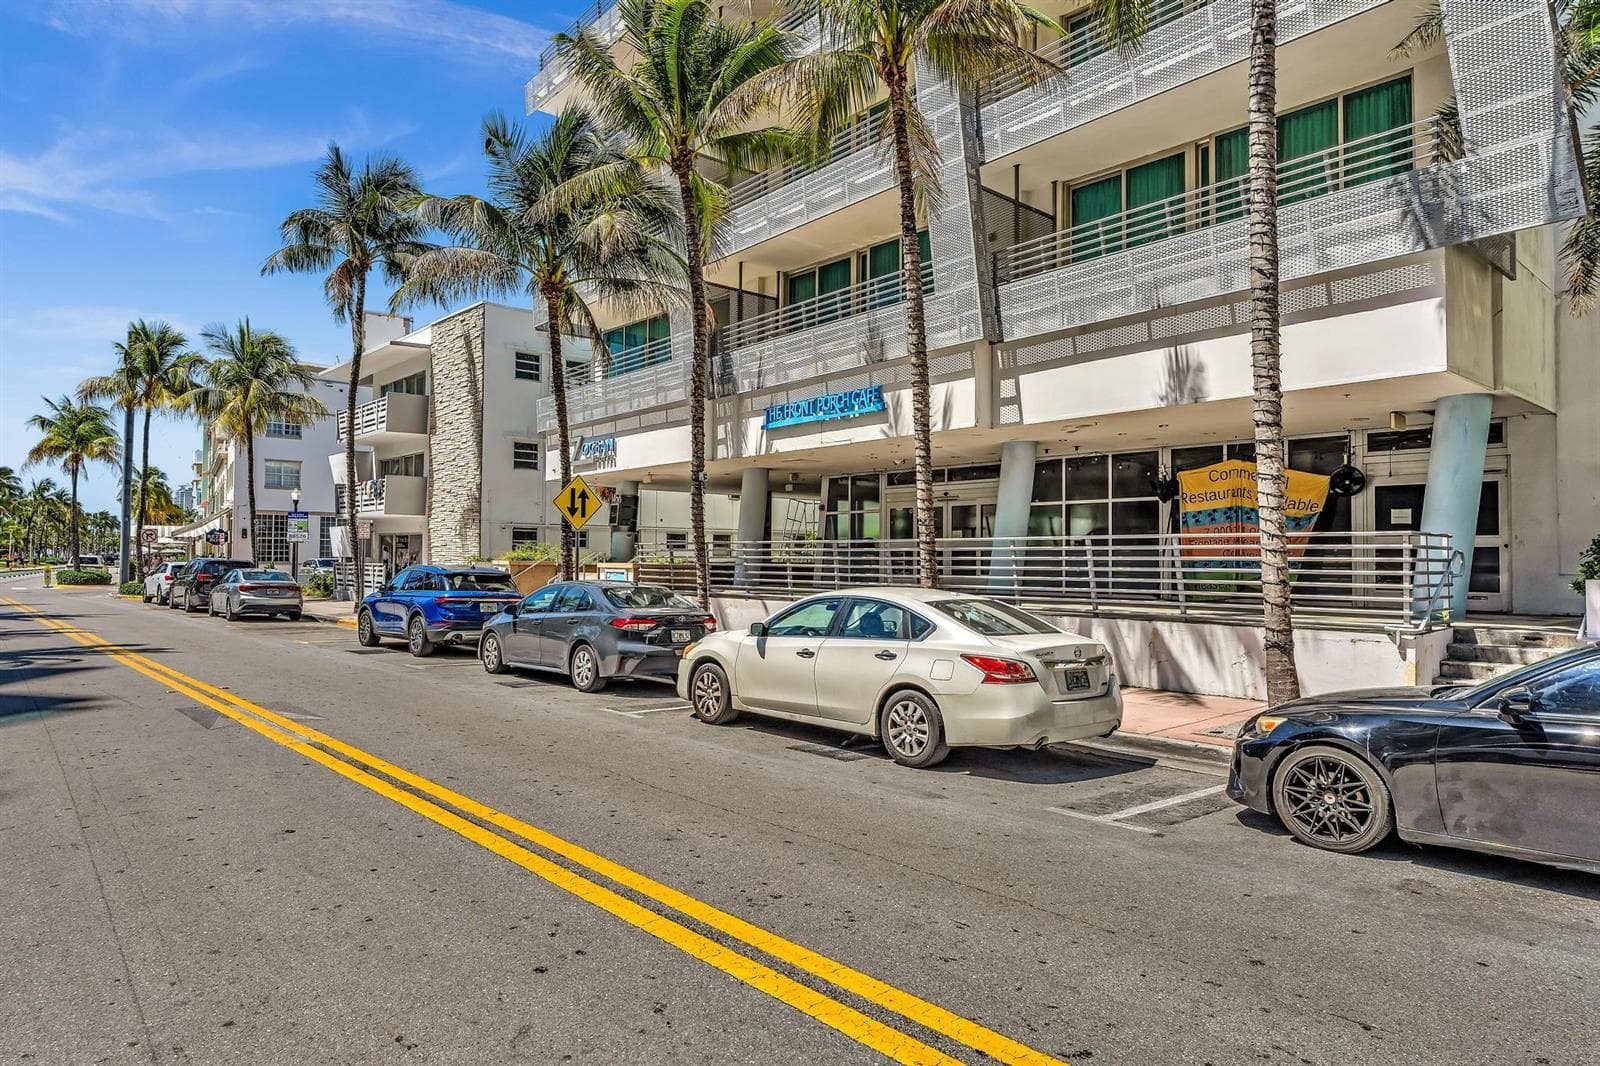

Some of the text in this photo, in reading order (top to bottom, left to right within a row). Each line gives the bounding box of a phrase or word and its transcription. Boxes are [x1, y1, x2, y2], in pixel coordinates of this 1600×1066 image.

[784, 399, 814, 419] FRONT
[817, 392, 850, 412] PORCH
[851, 386, 879, 408] CAFE
[1208, 468, 1290, 490] Commel
[1181, 487, 1253, 504] Restaurants
